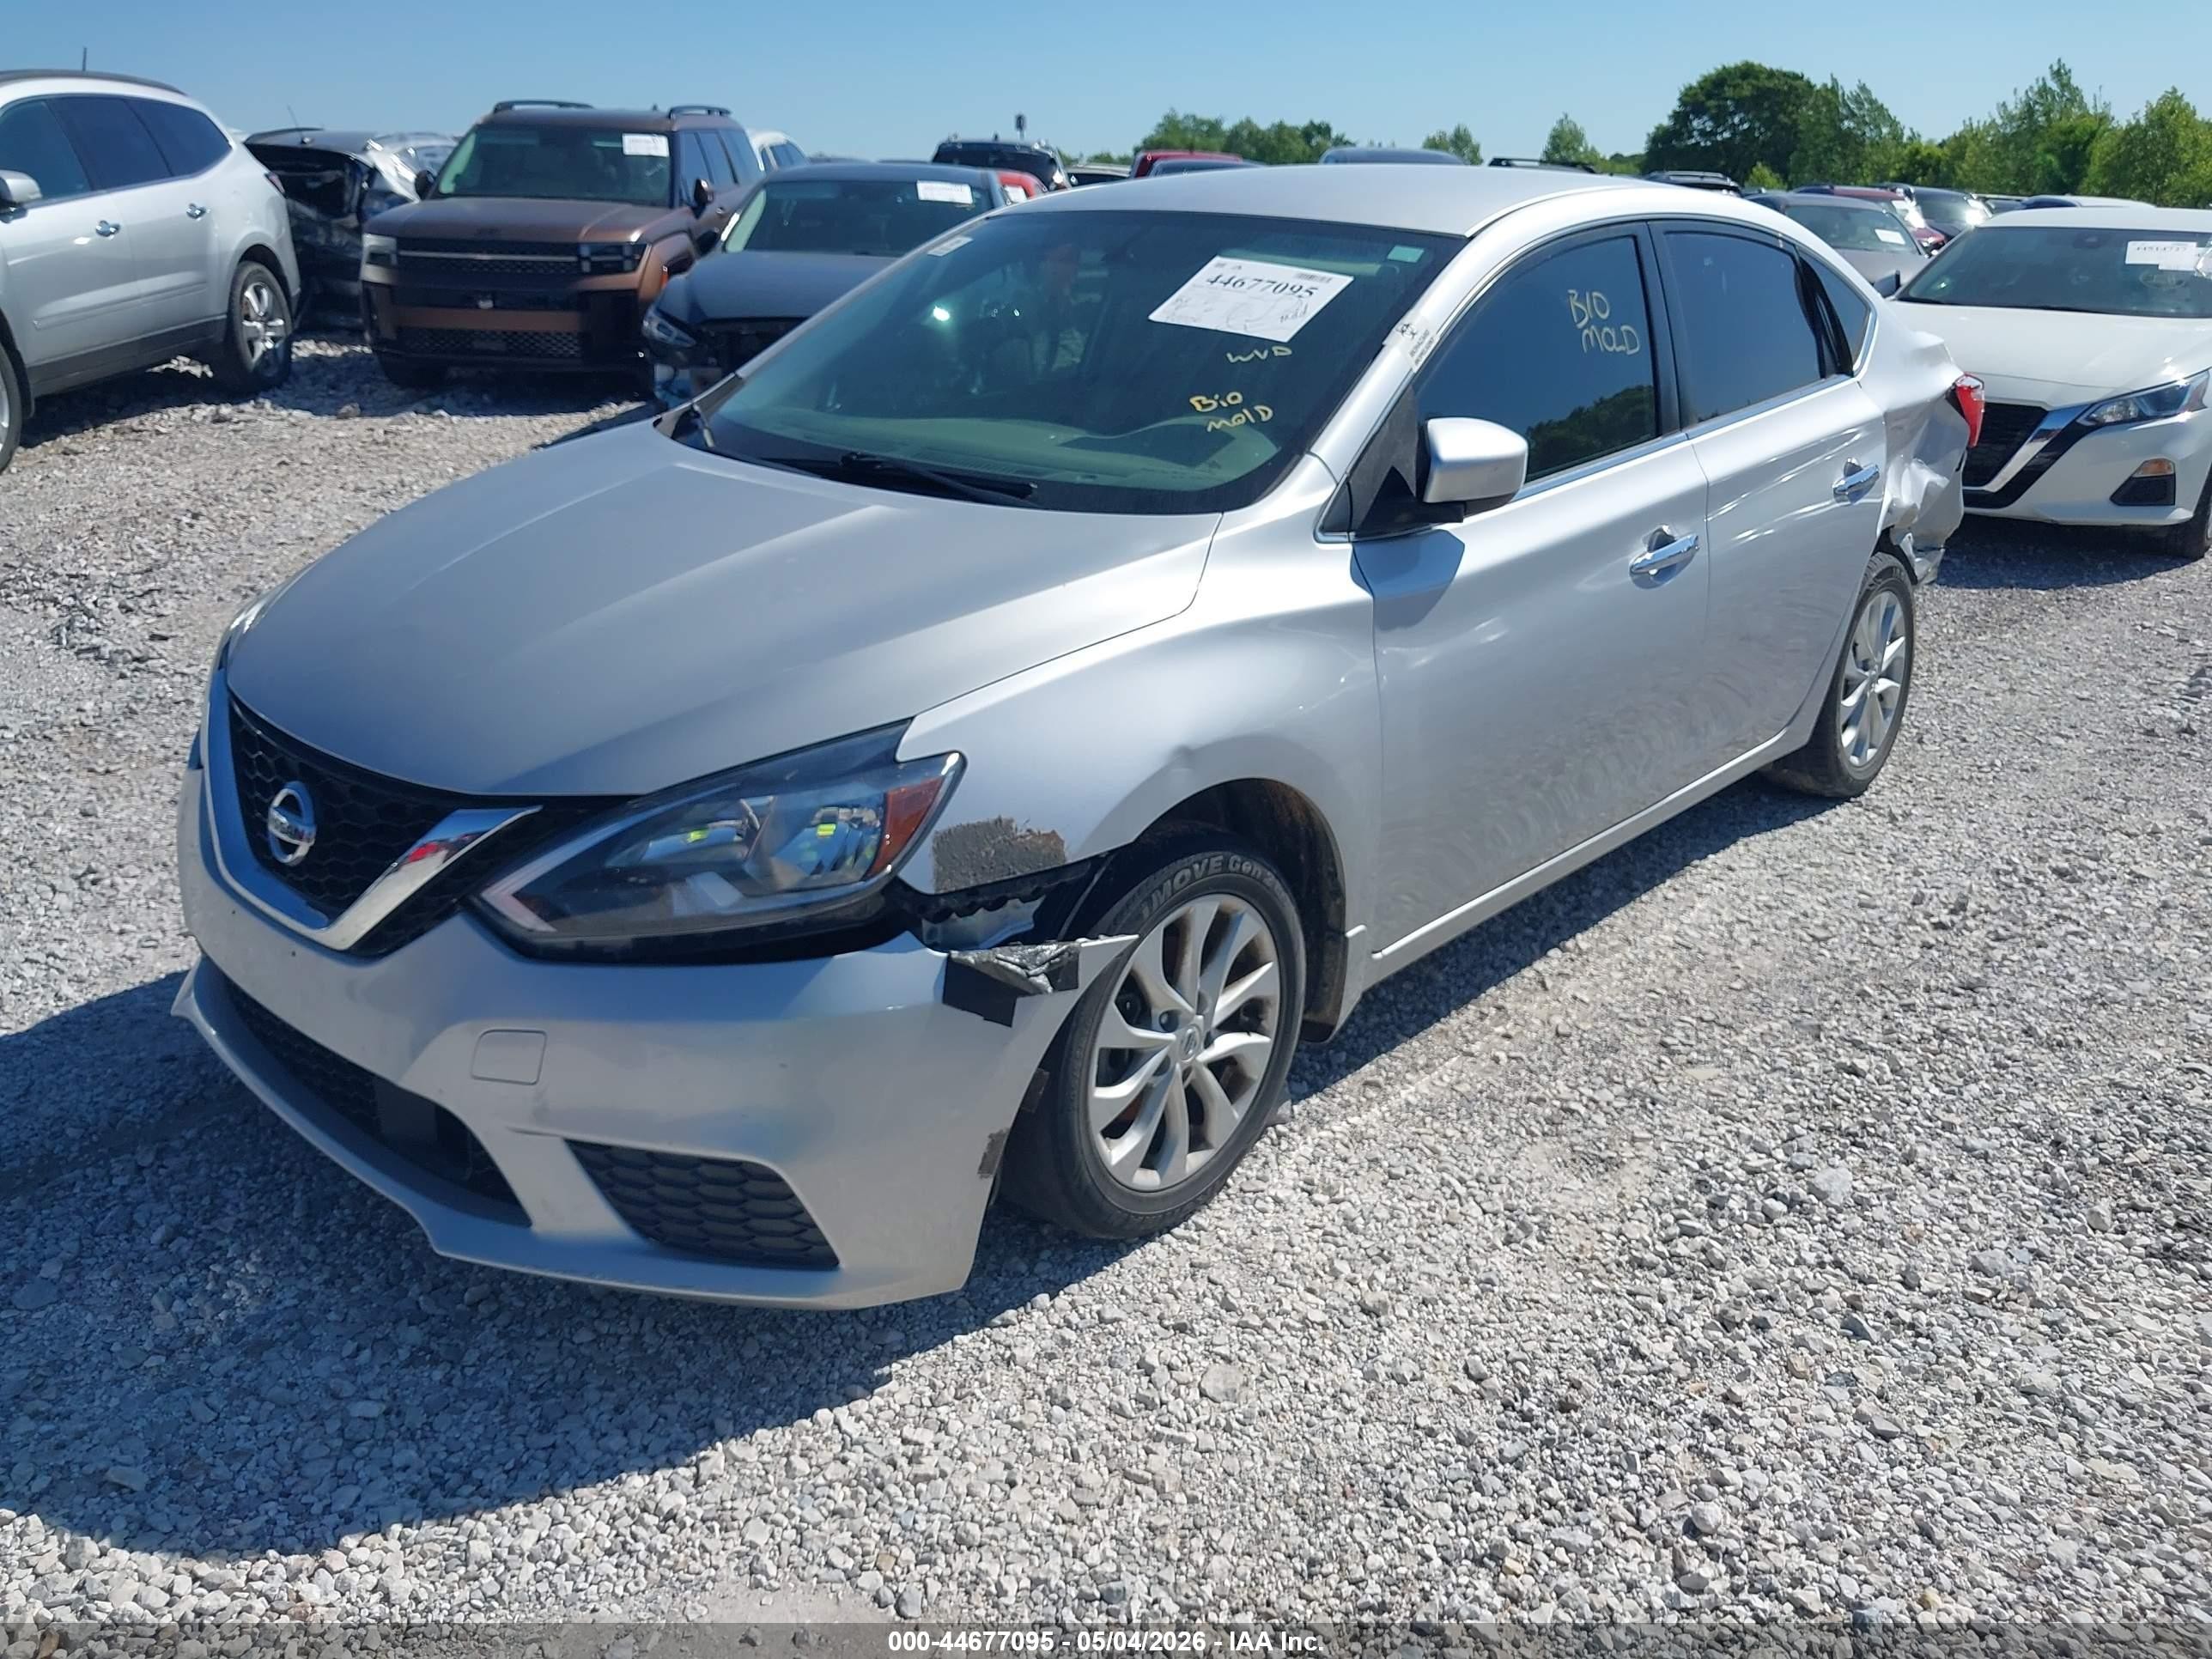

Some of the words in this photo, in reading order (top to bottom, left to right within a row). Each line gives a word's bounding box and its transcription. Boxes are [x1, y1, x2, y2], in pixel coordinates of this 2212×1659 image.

[1206, 274, 1319, 299] 44677095
[1567, 289, 1610, 329] BIO
[1582, 325, 1640, 355] MOLD
